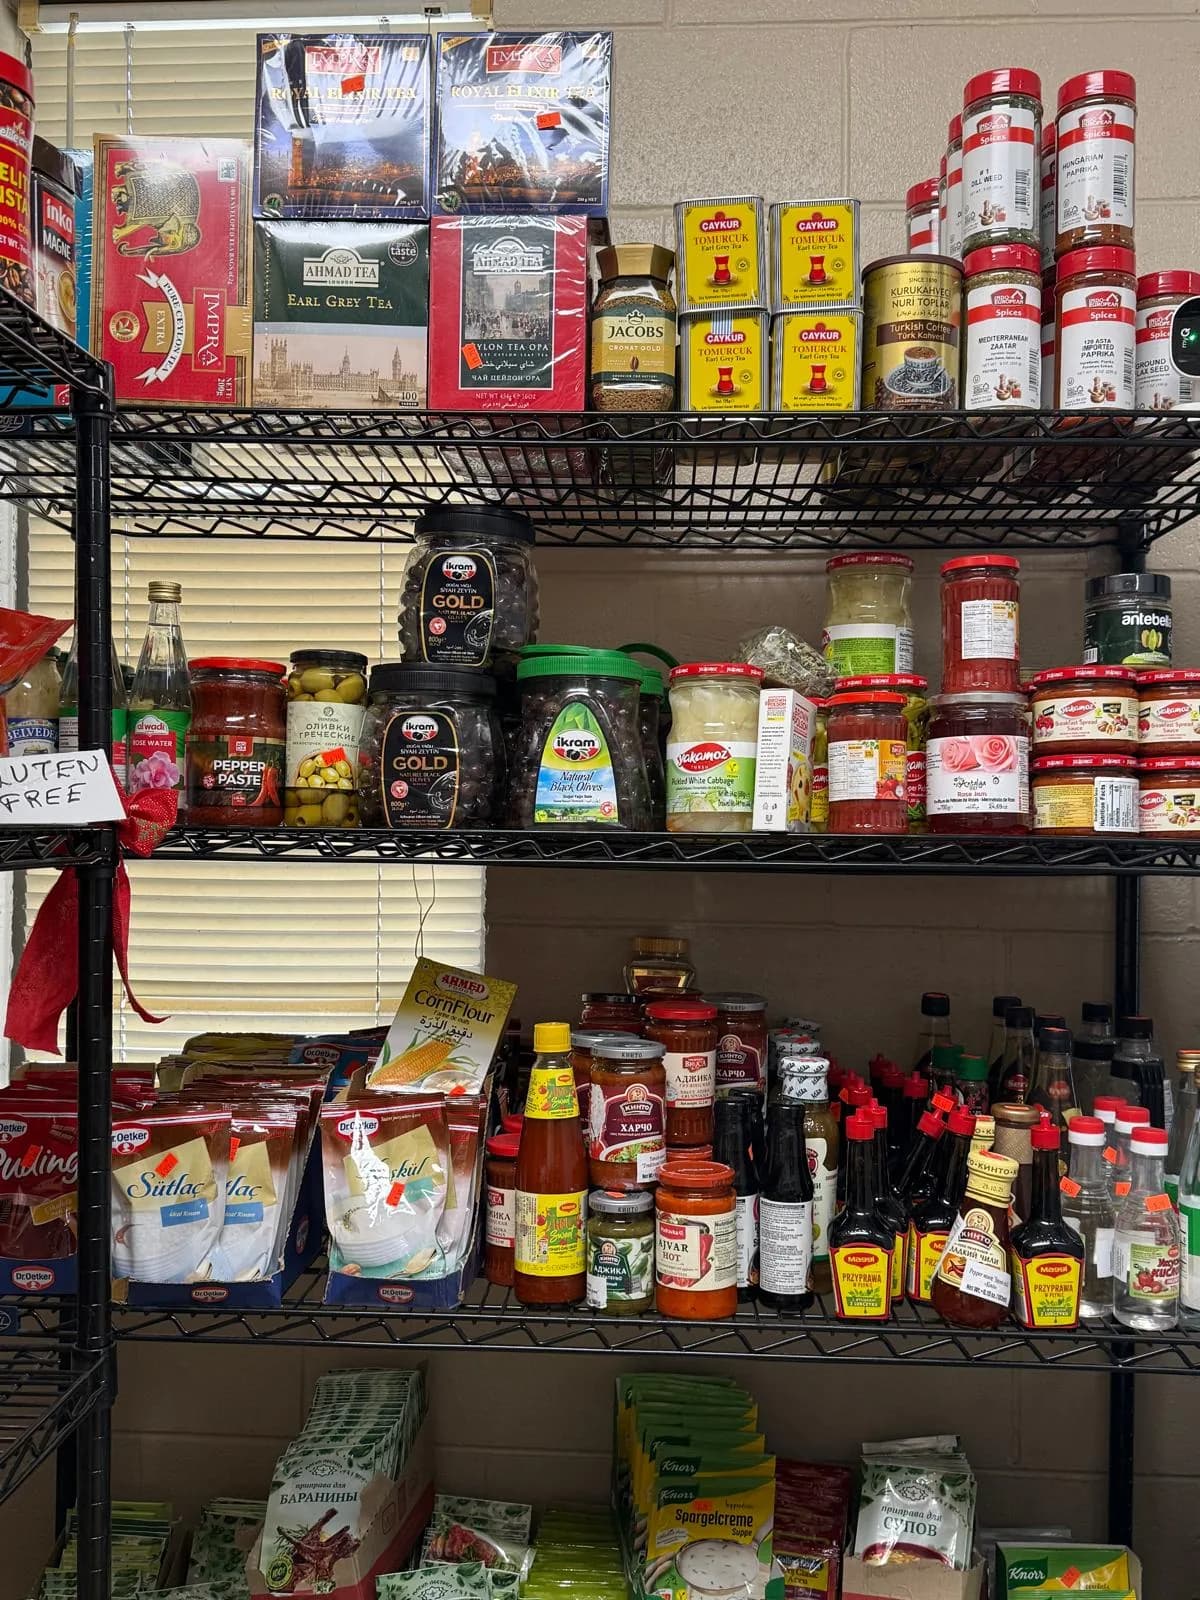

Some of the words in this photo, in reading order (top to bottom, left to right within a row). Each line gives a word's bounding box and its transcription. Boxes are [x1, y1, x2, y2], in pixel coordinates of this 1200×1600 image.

[980, 133, 1007, 144] Spices
[1083, 130, 1111, 138] Spices
[1062, 153, 1104, 170] HUNGARIAN
[1066, 165, 1099, 178] PAPRIKA
[45, 199, 72, 232] inka
[701, 220, 740, 233] ÇAYKUR
[798, 220, 837, 232] ÇAYKUR
[694, 233, 750, 245] TOMURCUK
[790, 234, 845, 245] TOMURCUK
[390, 246, 416, 256] taste
[701, 244, 715, 252] Earl
[715, 243, 732, 251] Grey
[475, 255, 519, 267] AHMAD
[521, 256, 542, 267] TEA
[306, 266, 351, 278] AHMAD
[353, 266, 377, 278] TEA
[288, 293, 320, 307] EARL
[326, 295, 361, 307] GREY
[367, 296, 393, 309] TEA
[163, 282, 180, 308] PURE
[173, 308, 184, 350] CEYLON
[995, 308, 1022, 318] Spices
[1090, 311, 1117, 320] Spices
[156, 310, 165, 346] EXTRA
[199, 293, 219, 366] IMPRA
[608, 325, 664, 338] JACOBS
[890, 322, 924, 333] Turkish
[925, 322, 952, 335] Coffee
[706, 332, 744, 344] ÇAYKUR
[801, 331, 839, 342] ÇAYKUR
[897, 332, 916, 341] Türk
[917, 331, 945, 341] Kahvesi
[978, 334, 1029, 344] MEDITERRANEAN
[477, 343, 503, 351] YLON
[507, 343, 526, 351] TEA
[529, 343, 549, 351] OPA
[698, 346, 753, 357] TOMURCUK
[791, 345, 848, 354] TOMURCUK
[990, 342, 1017, 350] ZAATAR
[719, 355, 736, 363] Grey
[813, 353, 829, 361] Grey
[1080, 350, 1115, 358] PAPRIKA
[1149, 365, 1170, 374] SEED
[401, 392, 417, 400] 100
[446, 562, 473, 571] ikram
[432, 594, 485, 609] GOLD
[306, 723, 350, 732] ОЛИВКИ
[406, 722, 434, 731] ikram
[299, 731, 356, 742] ГРЕЧЕСКИЕ
[557, 736, 595, 747] ikram
[213, 759, 266, 771] PEPPER
[392, 756, 448, 770] GOLD
[218, 774, 261, 785] PASTE
[560, 771, 594, 782] Natural
[688, 776, 706, 785] White
[707, 776, 735, 787] Cabbage
[550, 781, 575, 792] Black
[576, 781, 603, 792] Olives
[0, 782, 86, 813] FREE
[441, 974, 486, 994] AHMED
[675, 1074, 712, 1083] АДЖИКА
[624, 1103, 650, 1112] КИНТО
[620, 1123, 652, 1132] ХАРЧО
[977, 1162, 1010, 1175] КИНТО
[127, 1171, 204, 1202] Sütlaç
[961, 1231, 990, 1244] КИНТО
[659, 1239, 689, 1253] AJVAR
[662, 1251, 681, 1262] HOT
[847, 1256, 875, 1264] Maggi
[980, 1255, 999, 1265] ЧИЛИ
[593, 1265, 627, 1275] АДЖИКА
[1040, 1265, 1068, 1273] Maggi
[16, 1271, 51, 1282] Dr.Oetker
[842, 1272, 882, 1283] PRZYPRAWA
[1034, 1284, 1073, 1293] PRZYPRAWA
[662, 1461, 697, 1473] Knorr
[279, 1491, 358, 1505] БАРАНИНЫ
[660, 1488, 695, 1500] Knorr
[880, 1505, 924, 1519] приправа
[675, 1508, 753, 1528] Spargelcreme
[883, 1516, 937, 1537] СУПОВ
[731, 1528, 753, 1538] Suppe
[1008, 1567, 1046, 1580] Knorr
